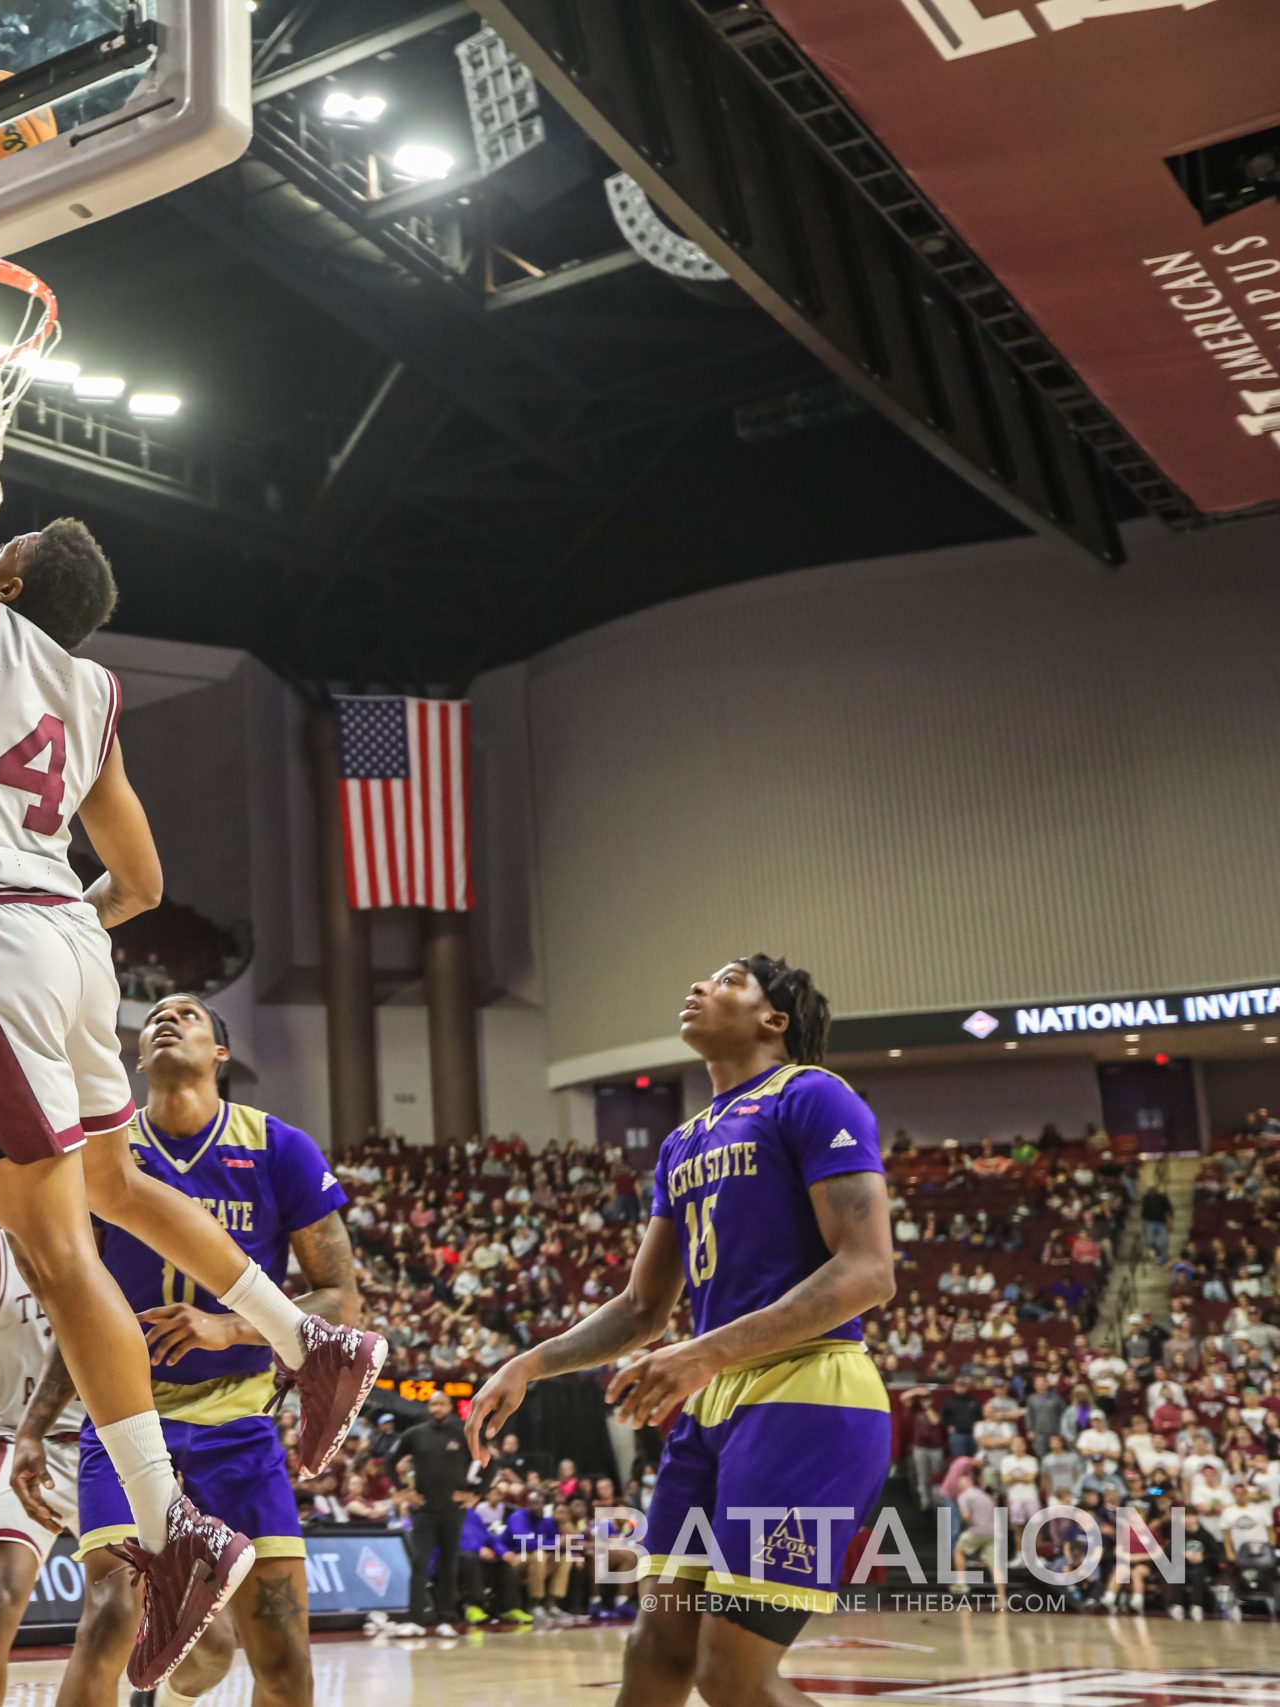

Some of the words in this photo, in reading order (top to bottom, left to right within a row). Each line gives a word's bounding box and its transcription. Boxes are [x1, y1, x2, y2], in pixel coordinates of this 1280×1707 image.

[1142, 250, 1279, 381] AMERICAN
[1015, 999, 1178, 1034] NATIONAL
[704, 1142, 758, 1184] STATE
[191, 1197, 254, 1232] TATE
[685, 1192, 718, 1288] 15
